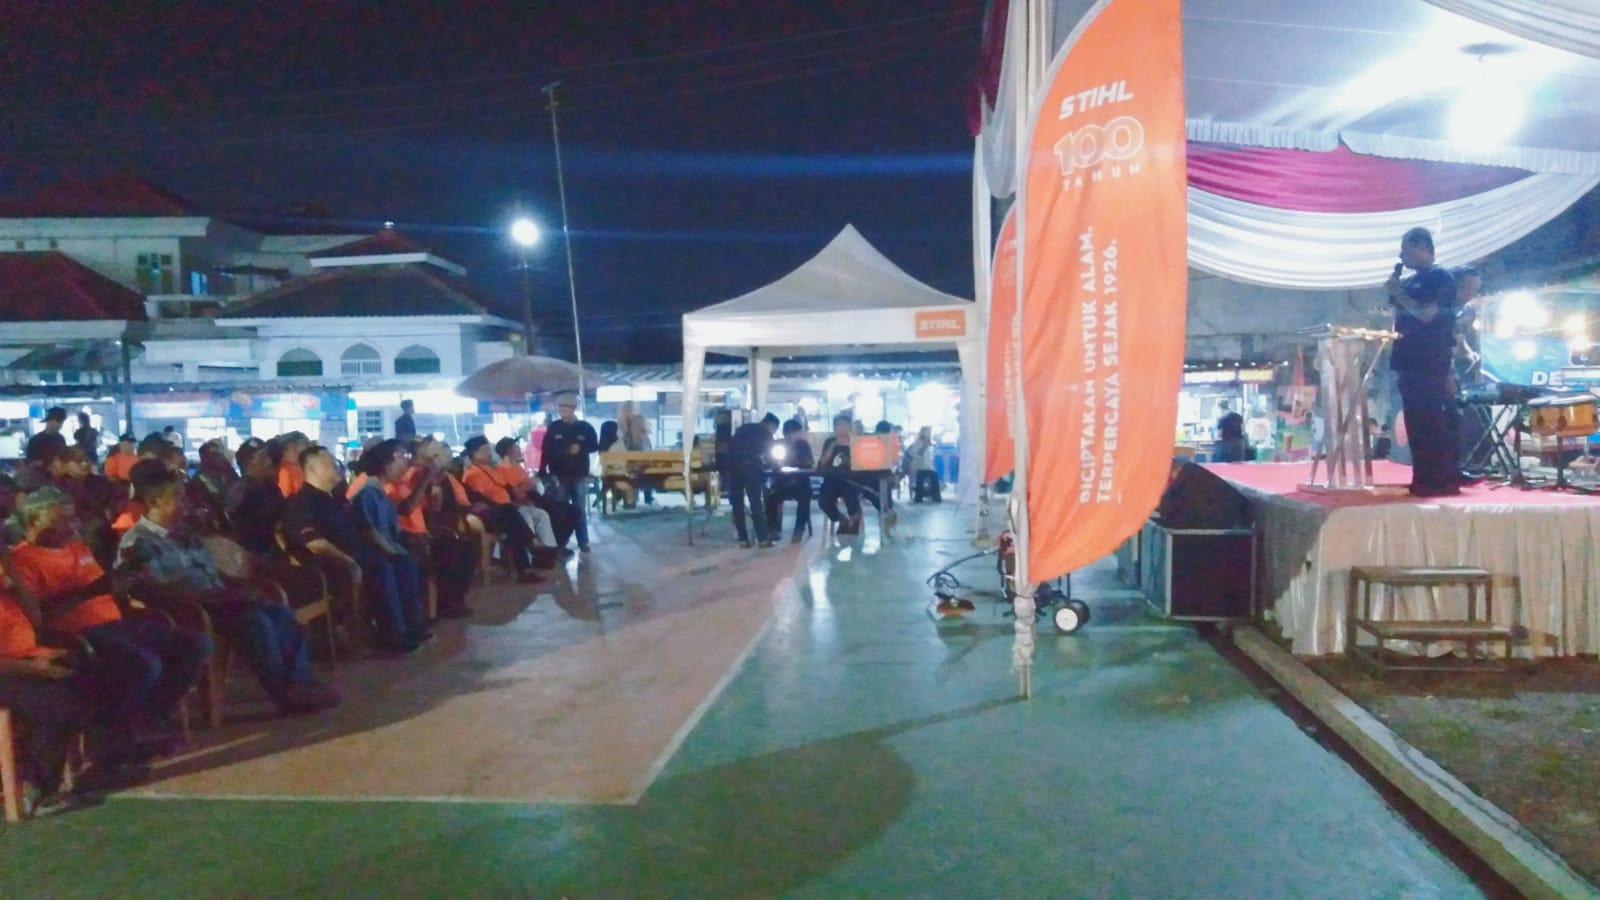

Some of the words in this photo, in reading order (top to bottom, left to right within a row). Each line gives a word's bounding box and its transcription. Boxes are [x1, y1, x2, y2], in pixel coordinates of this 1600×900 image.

[1058, 80, 1134, 120] STIHL
[1054, 116, 1144, 176] 100
[1063, 163, 1140, 192] TAHUN
[1079, 226, 1096, 293] ALAM.
[1103, 238, 1118, 295] 1926.
[1082, 300, 1097, 373] UNTUK
[1103, 302, 1119, 367] SEJAK
[1080, 379, 1096, 504] DICIPTAKAN
[1096, 373, 1119, 504] TERPERCAYA
